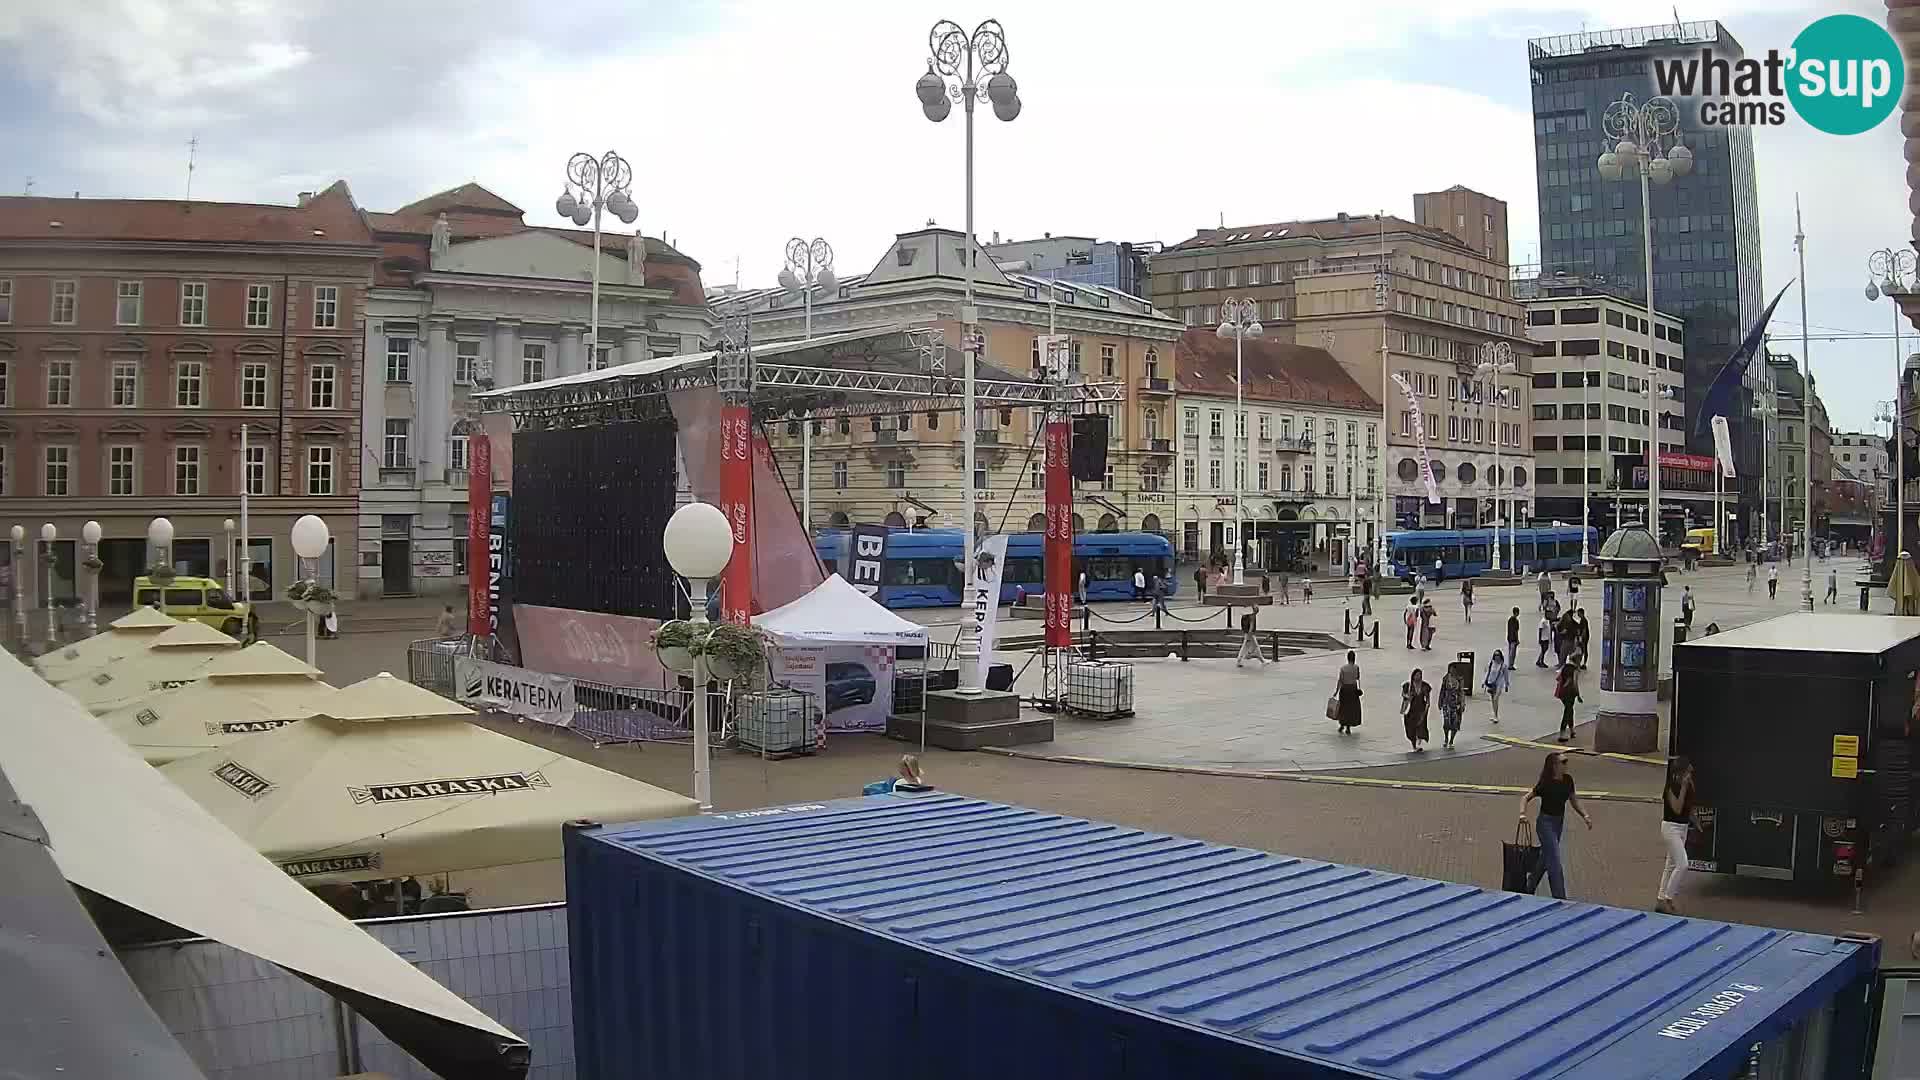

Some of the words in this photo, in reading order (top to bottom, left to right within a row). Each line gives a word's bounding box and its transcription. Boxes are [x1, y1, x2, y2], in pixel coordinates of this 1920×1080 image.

[487, 675, 563, 712] KERATERM
[381, 776, 522, 800] MARASKA
[287, 857, 365, 875] MARASKA
